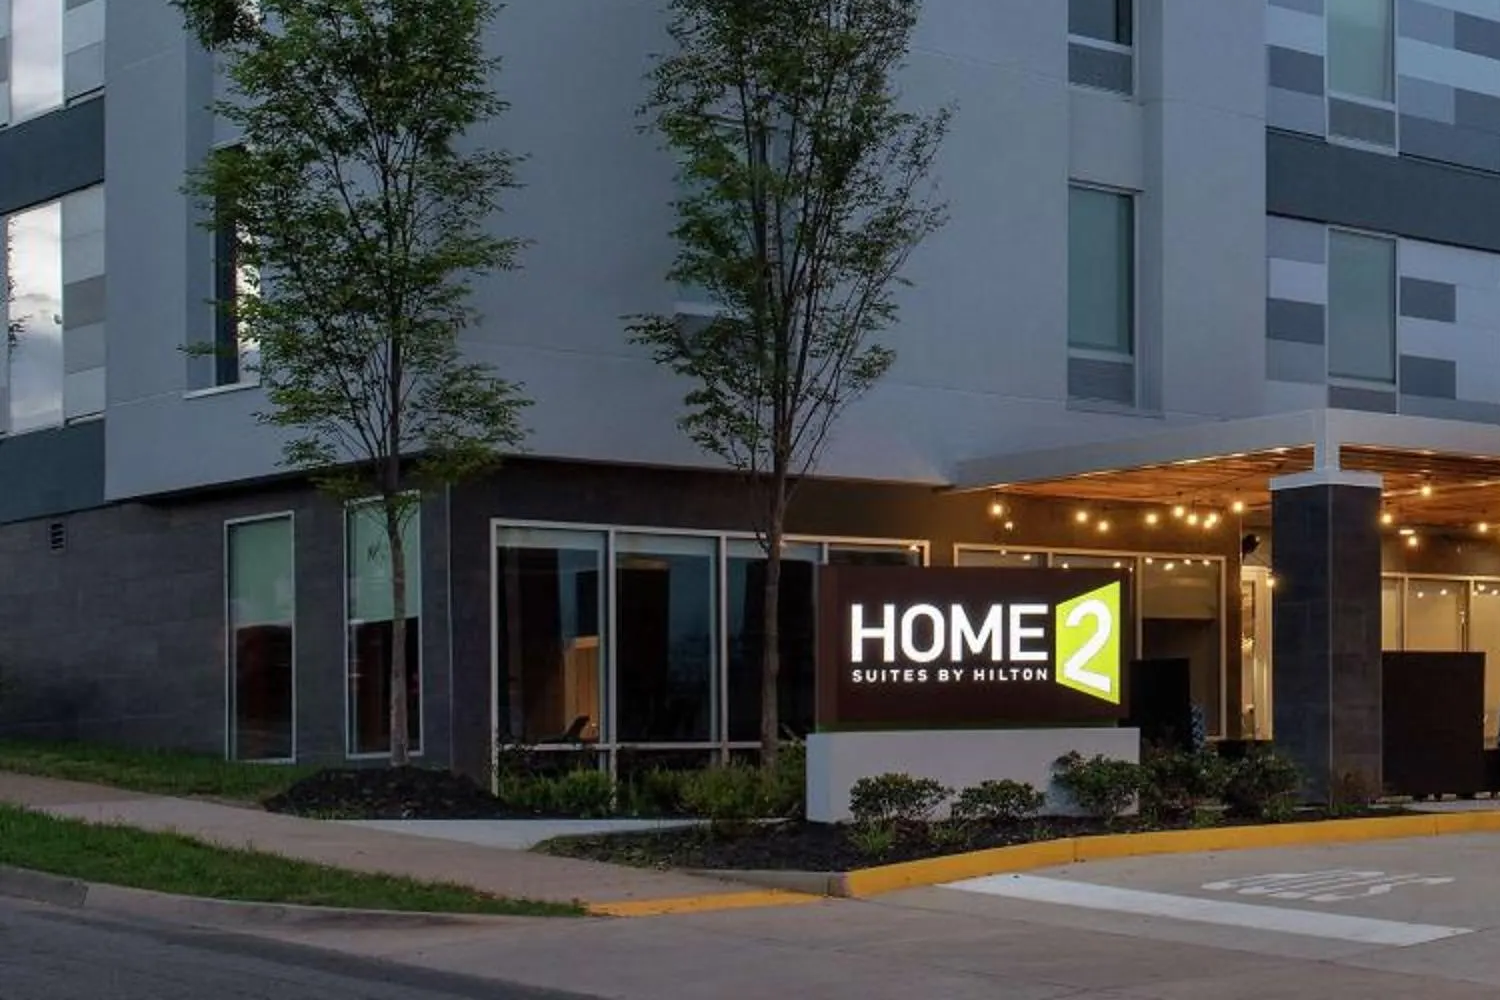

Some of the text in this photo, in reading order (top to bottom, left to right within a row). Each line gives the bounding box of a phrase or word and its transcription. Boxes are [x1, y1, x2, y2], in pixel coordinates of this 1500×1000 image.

[850, 599, 1112, 693] HOME 2
[851, 668, 1048, 683] SUITES BY HILTON
